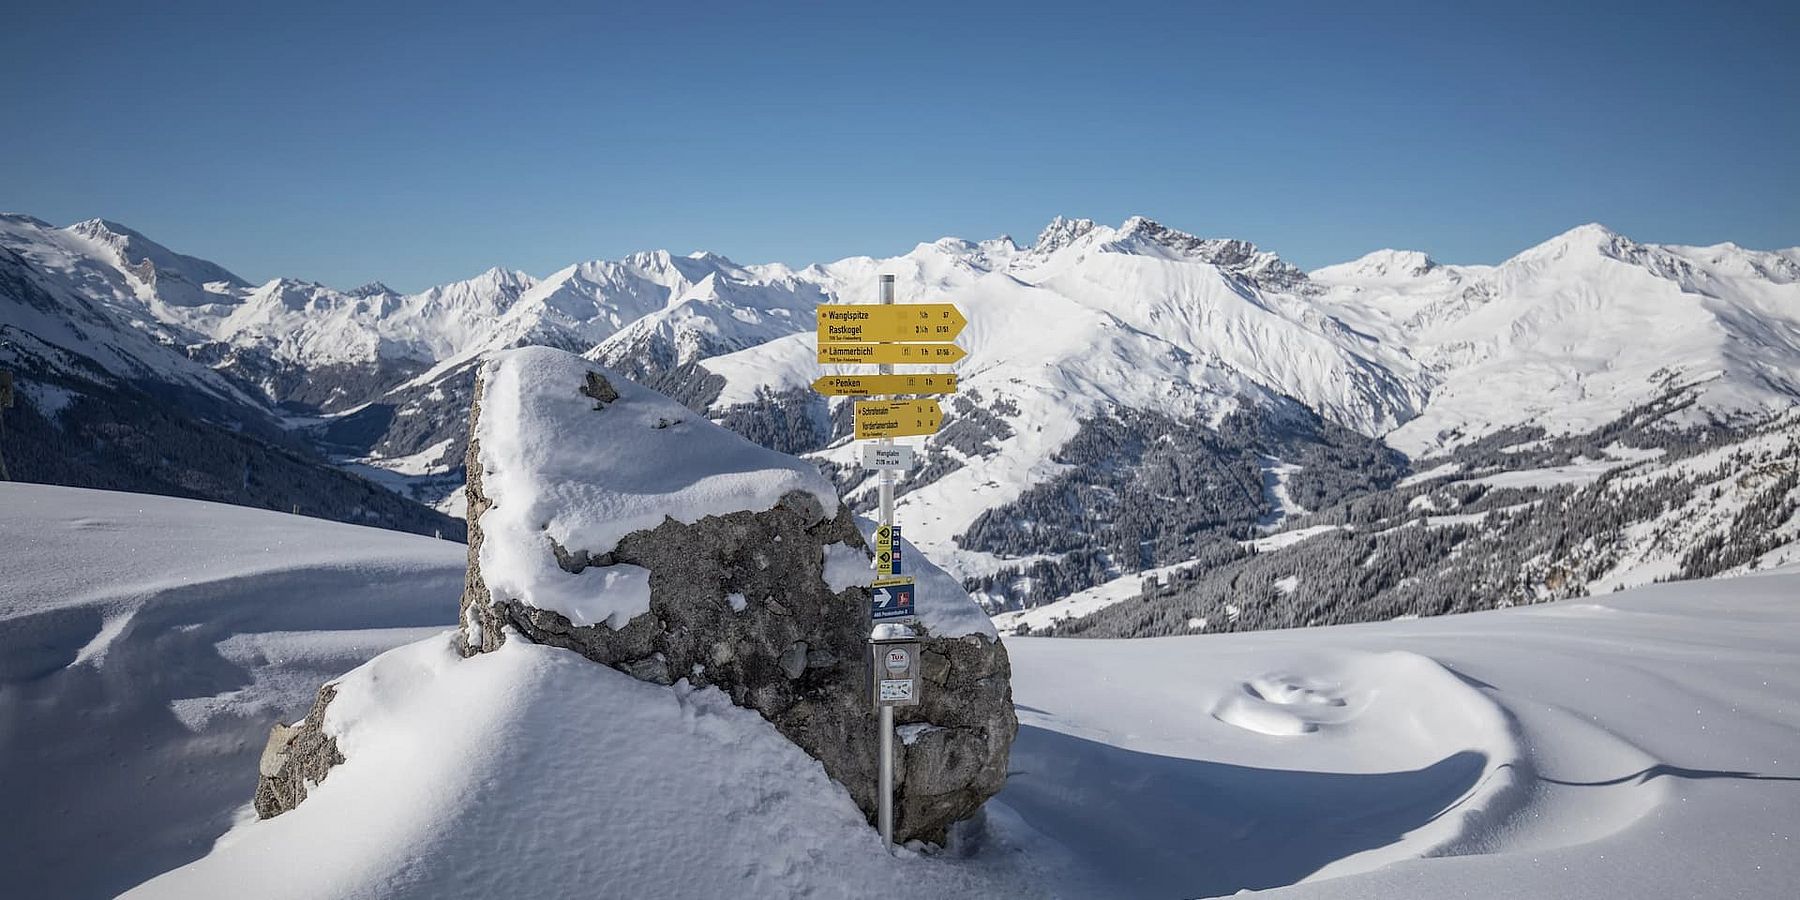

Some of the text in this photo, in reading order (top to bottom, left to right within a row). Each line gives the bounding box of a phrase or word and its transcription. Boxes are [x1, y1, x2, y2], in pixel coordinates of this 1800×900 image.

[829, 311, 869, 321] Wanglspitze
[829, 325, 862, 336] Rastkogel
[829, 346, 873, 356] Lämmerbichl
[835, 378, 861, 388] Penken
